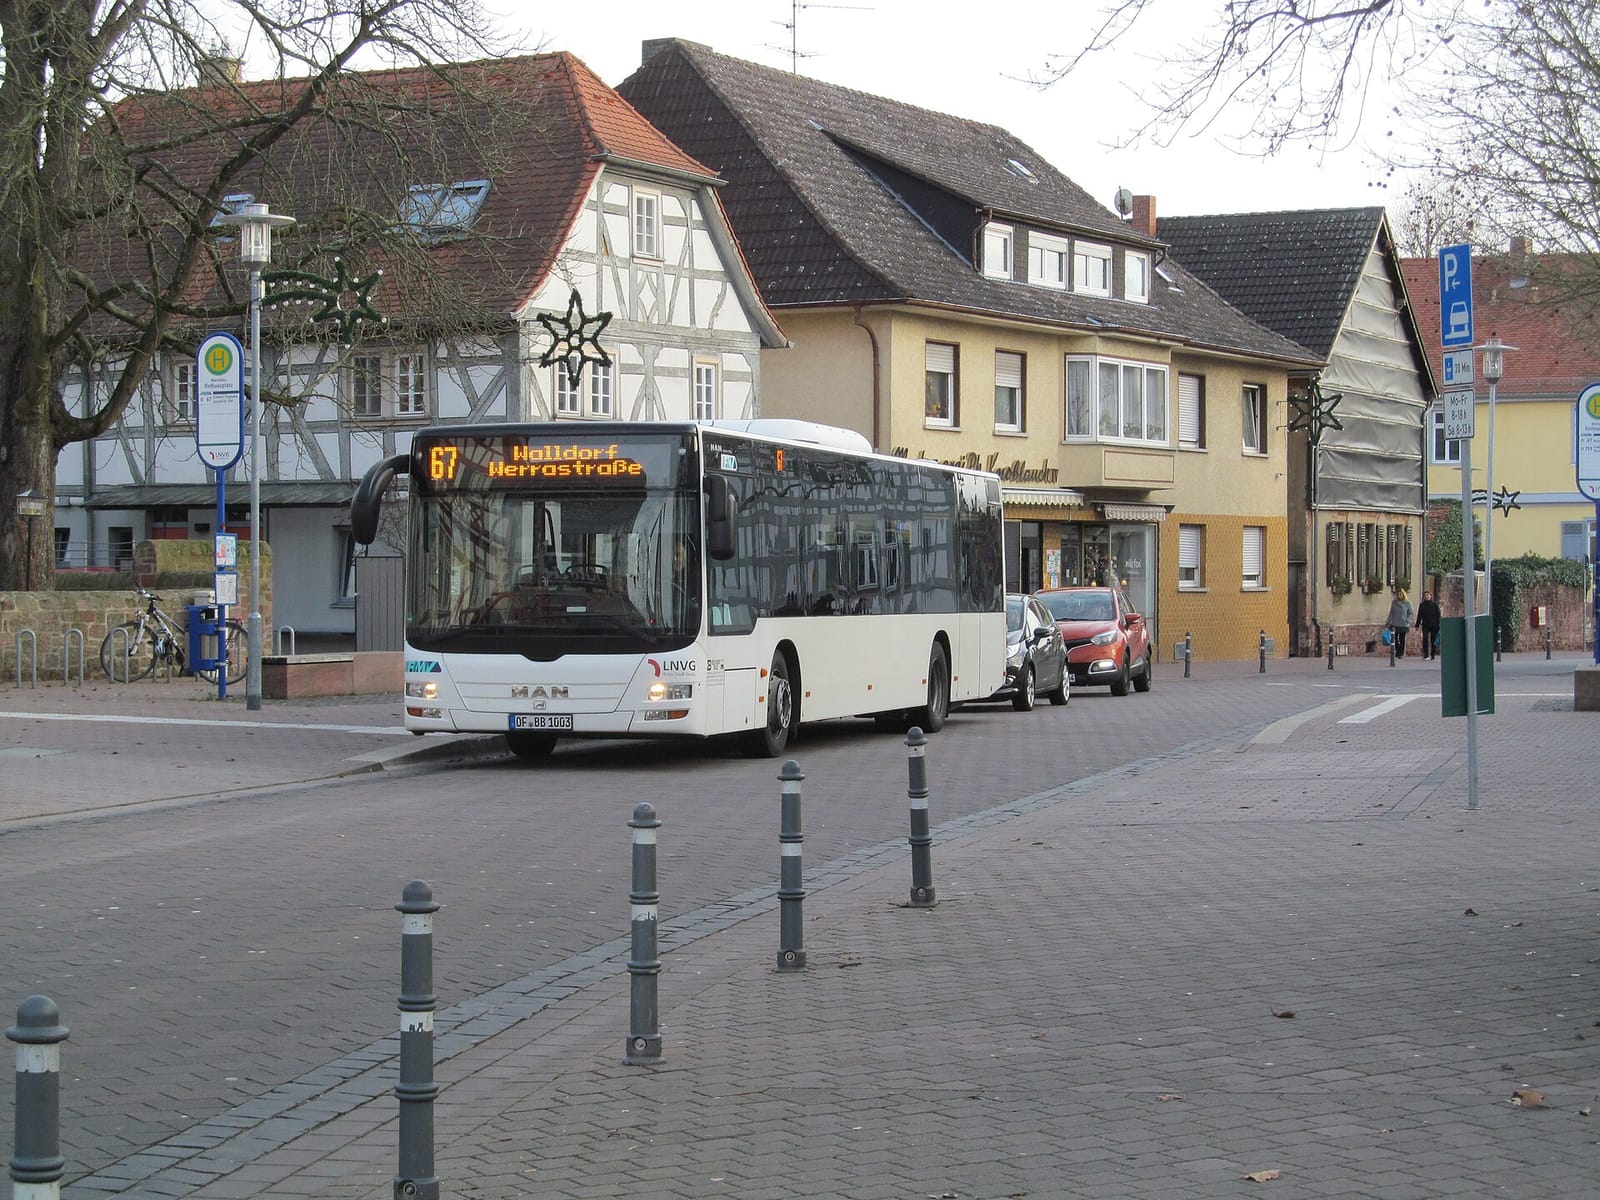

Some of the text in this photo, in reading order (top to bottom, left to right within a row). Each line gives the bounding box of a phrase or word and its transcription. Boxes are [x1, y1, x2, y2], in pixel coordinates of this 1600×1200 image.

[1444, 253, 1458, 292] P
[212, 350, 225, 369] H
[430, 444, 618, 480] 67 Walldorf
[488, 460, 643, 477] Werrastraße
[663, 660, 696, 671] LNVG
[511, 685, 569, 698] MAN
[516, 716, 571, 728] OF BB 1003
